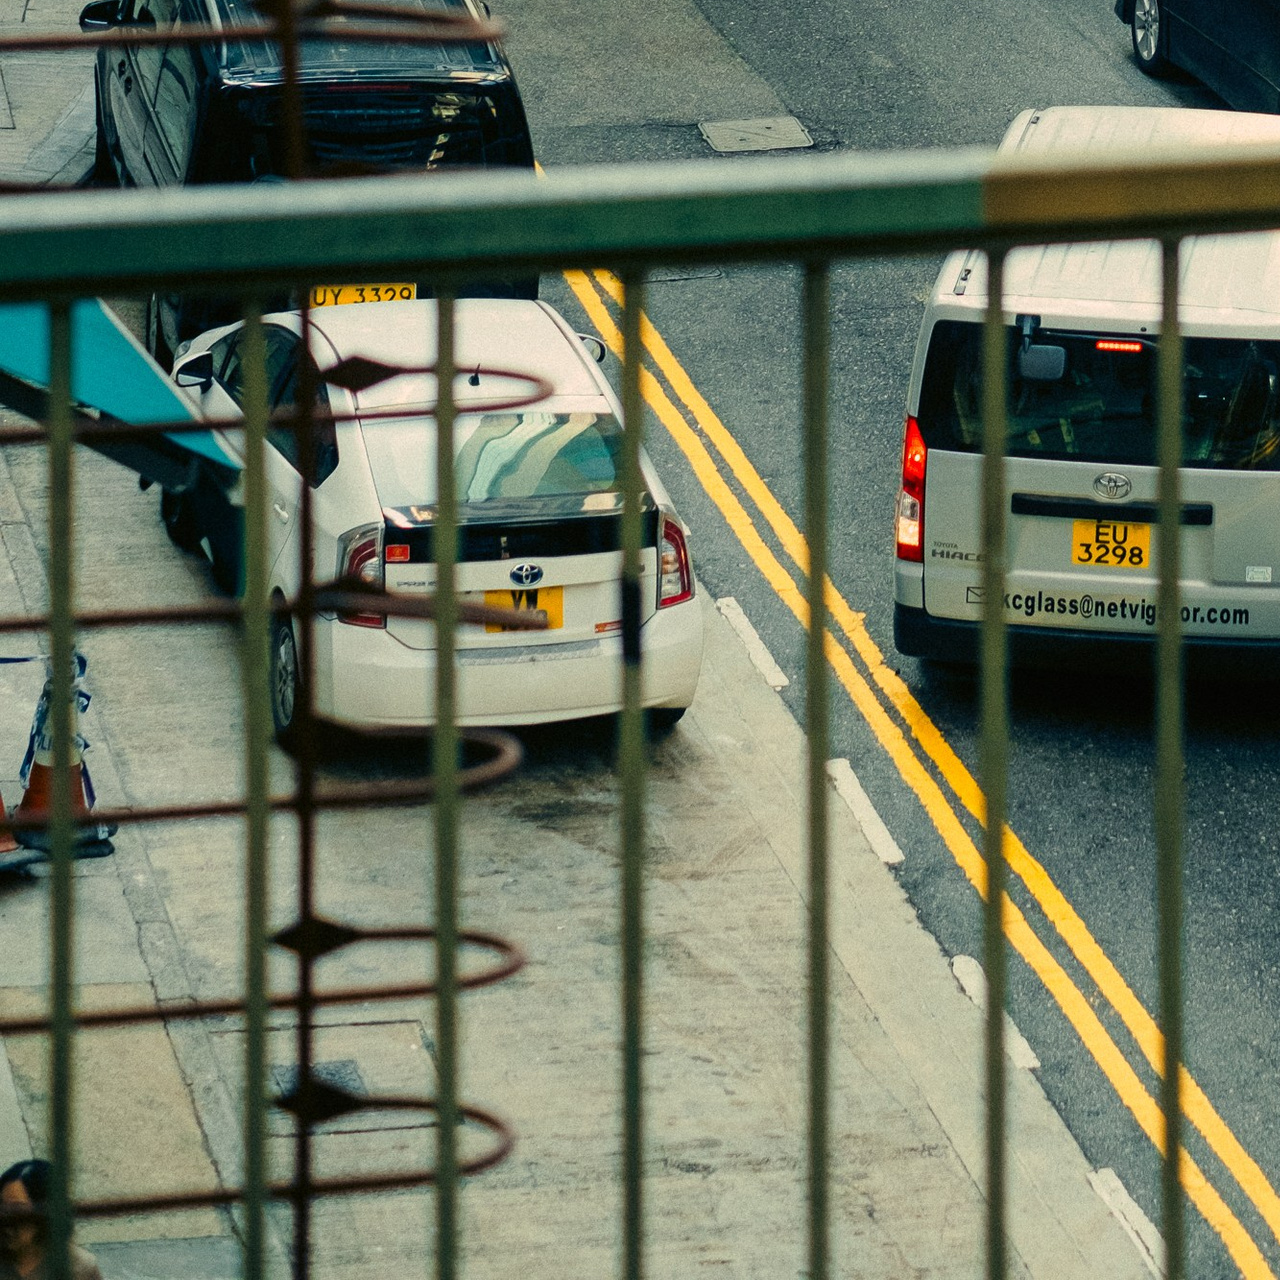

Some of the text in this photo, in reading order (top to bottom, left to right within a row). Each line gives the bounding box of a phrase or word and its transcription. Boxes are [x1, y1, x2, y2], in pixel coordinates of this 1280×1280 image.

[314, 288, 342, 306] UY
[1095, 524, 1128, 544] EU
[1077, 543, 1144, 566] 3298
